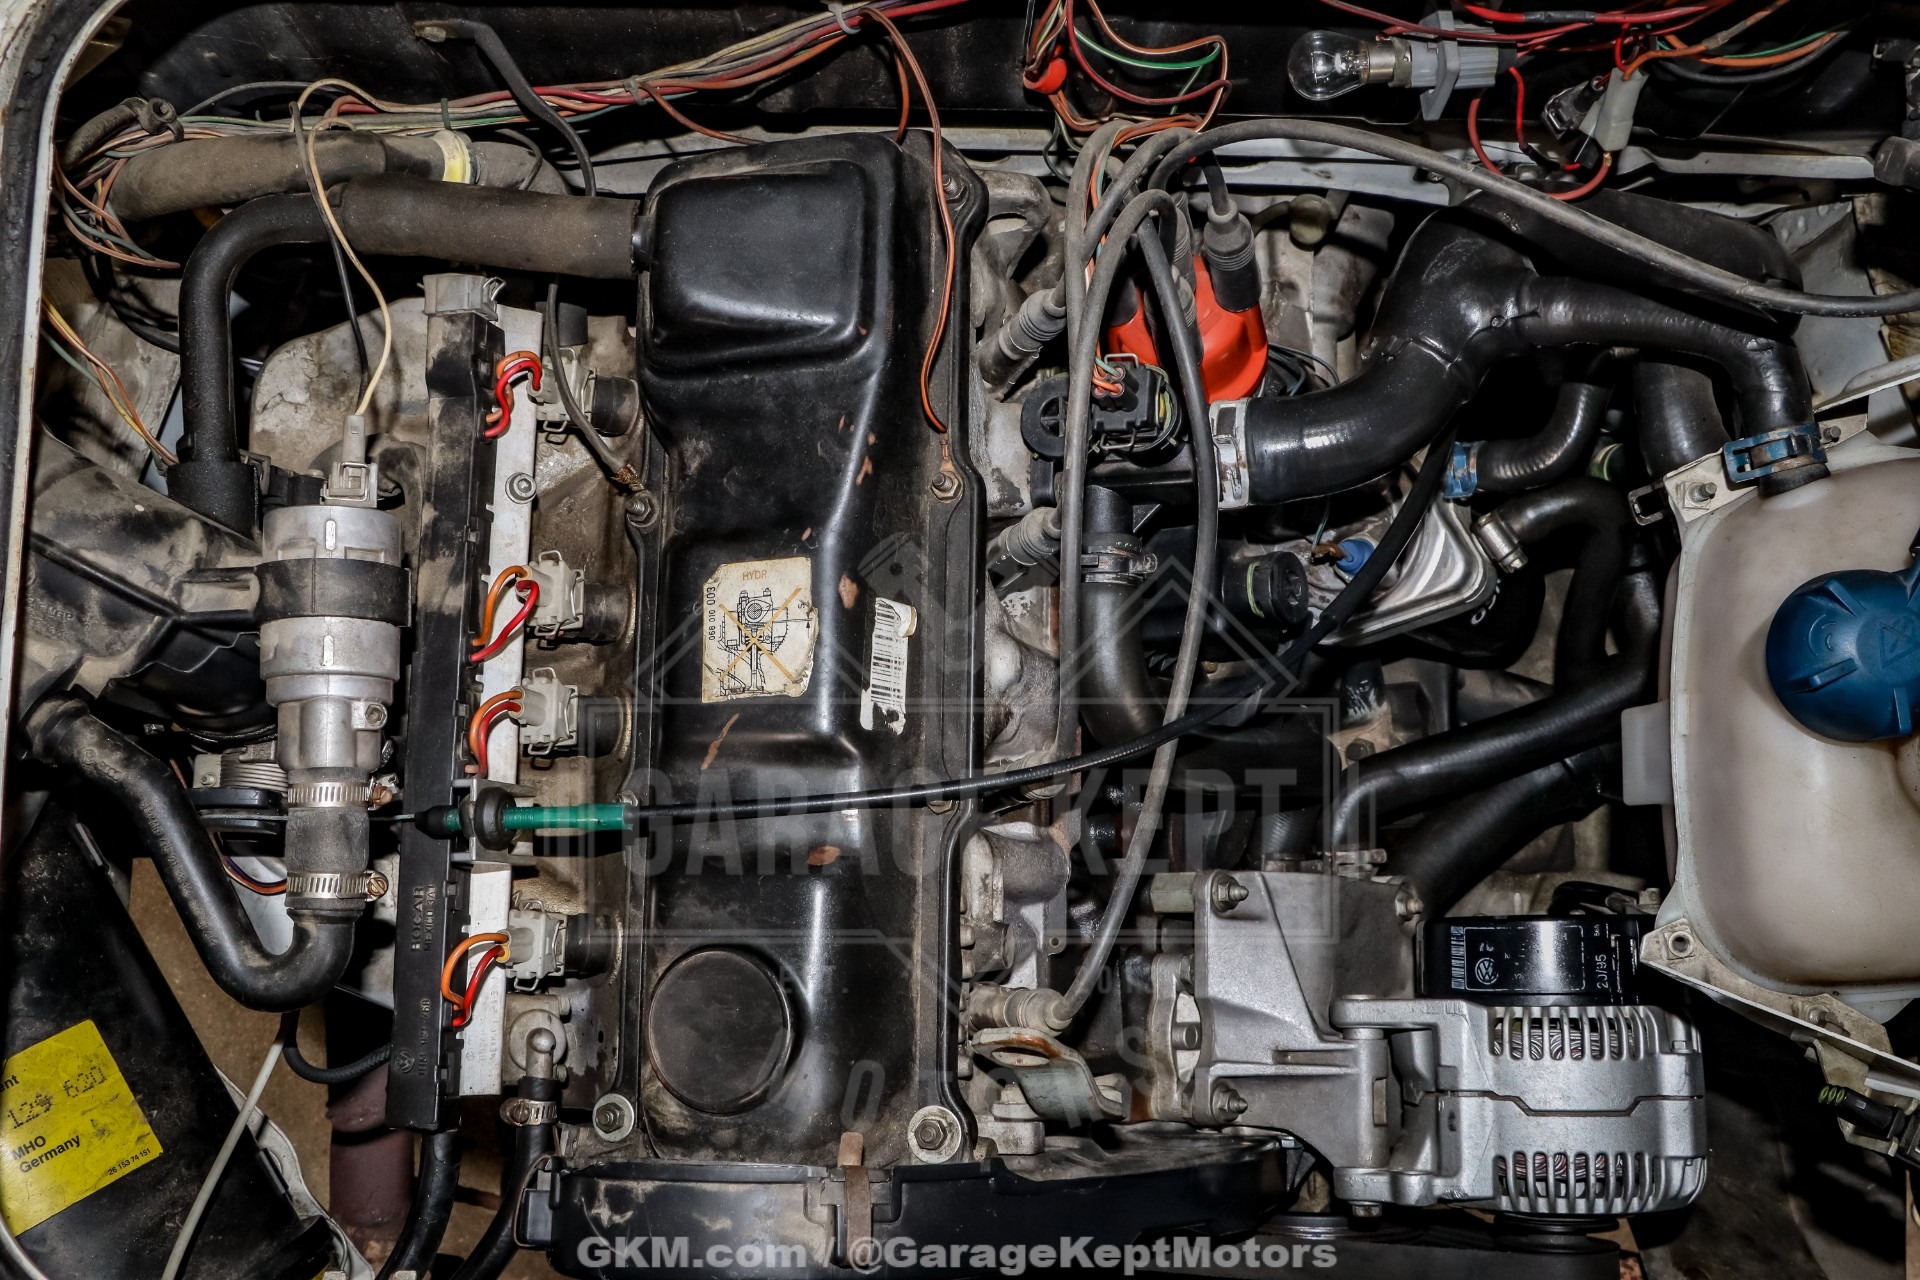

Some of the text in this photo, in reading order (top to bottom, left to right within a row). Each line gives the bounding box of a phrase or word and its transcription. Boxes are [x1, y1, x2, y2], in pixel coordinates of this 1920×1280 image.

[706, 586, 716, 606] 003
[708, 609, 716, 622] 010
[410, 886, 424, 952] BOCAR
[423, 910, 434, 952] MEXICO
[12, 1135, 47, 1162] MHO
[18, 1133, 82, 1175] Germany
[107, 1166, 118, 1175] 26
